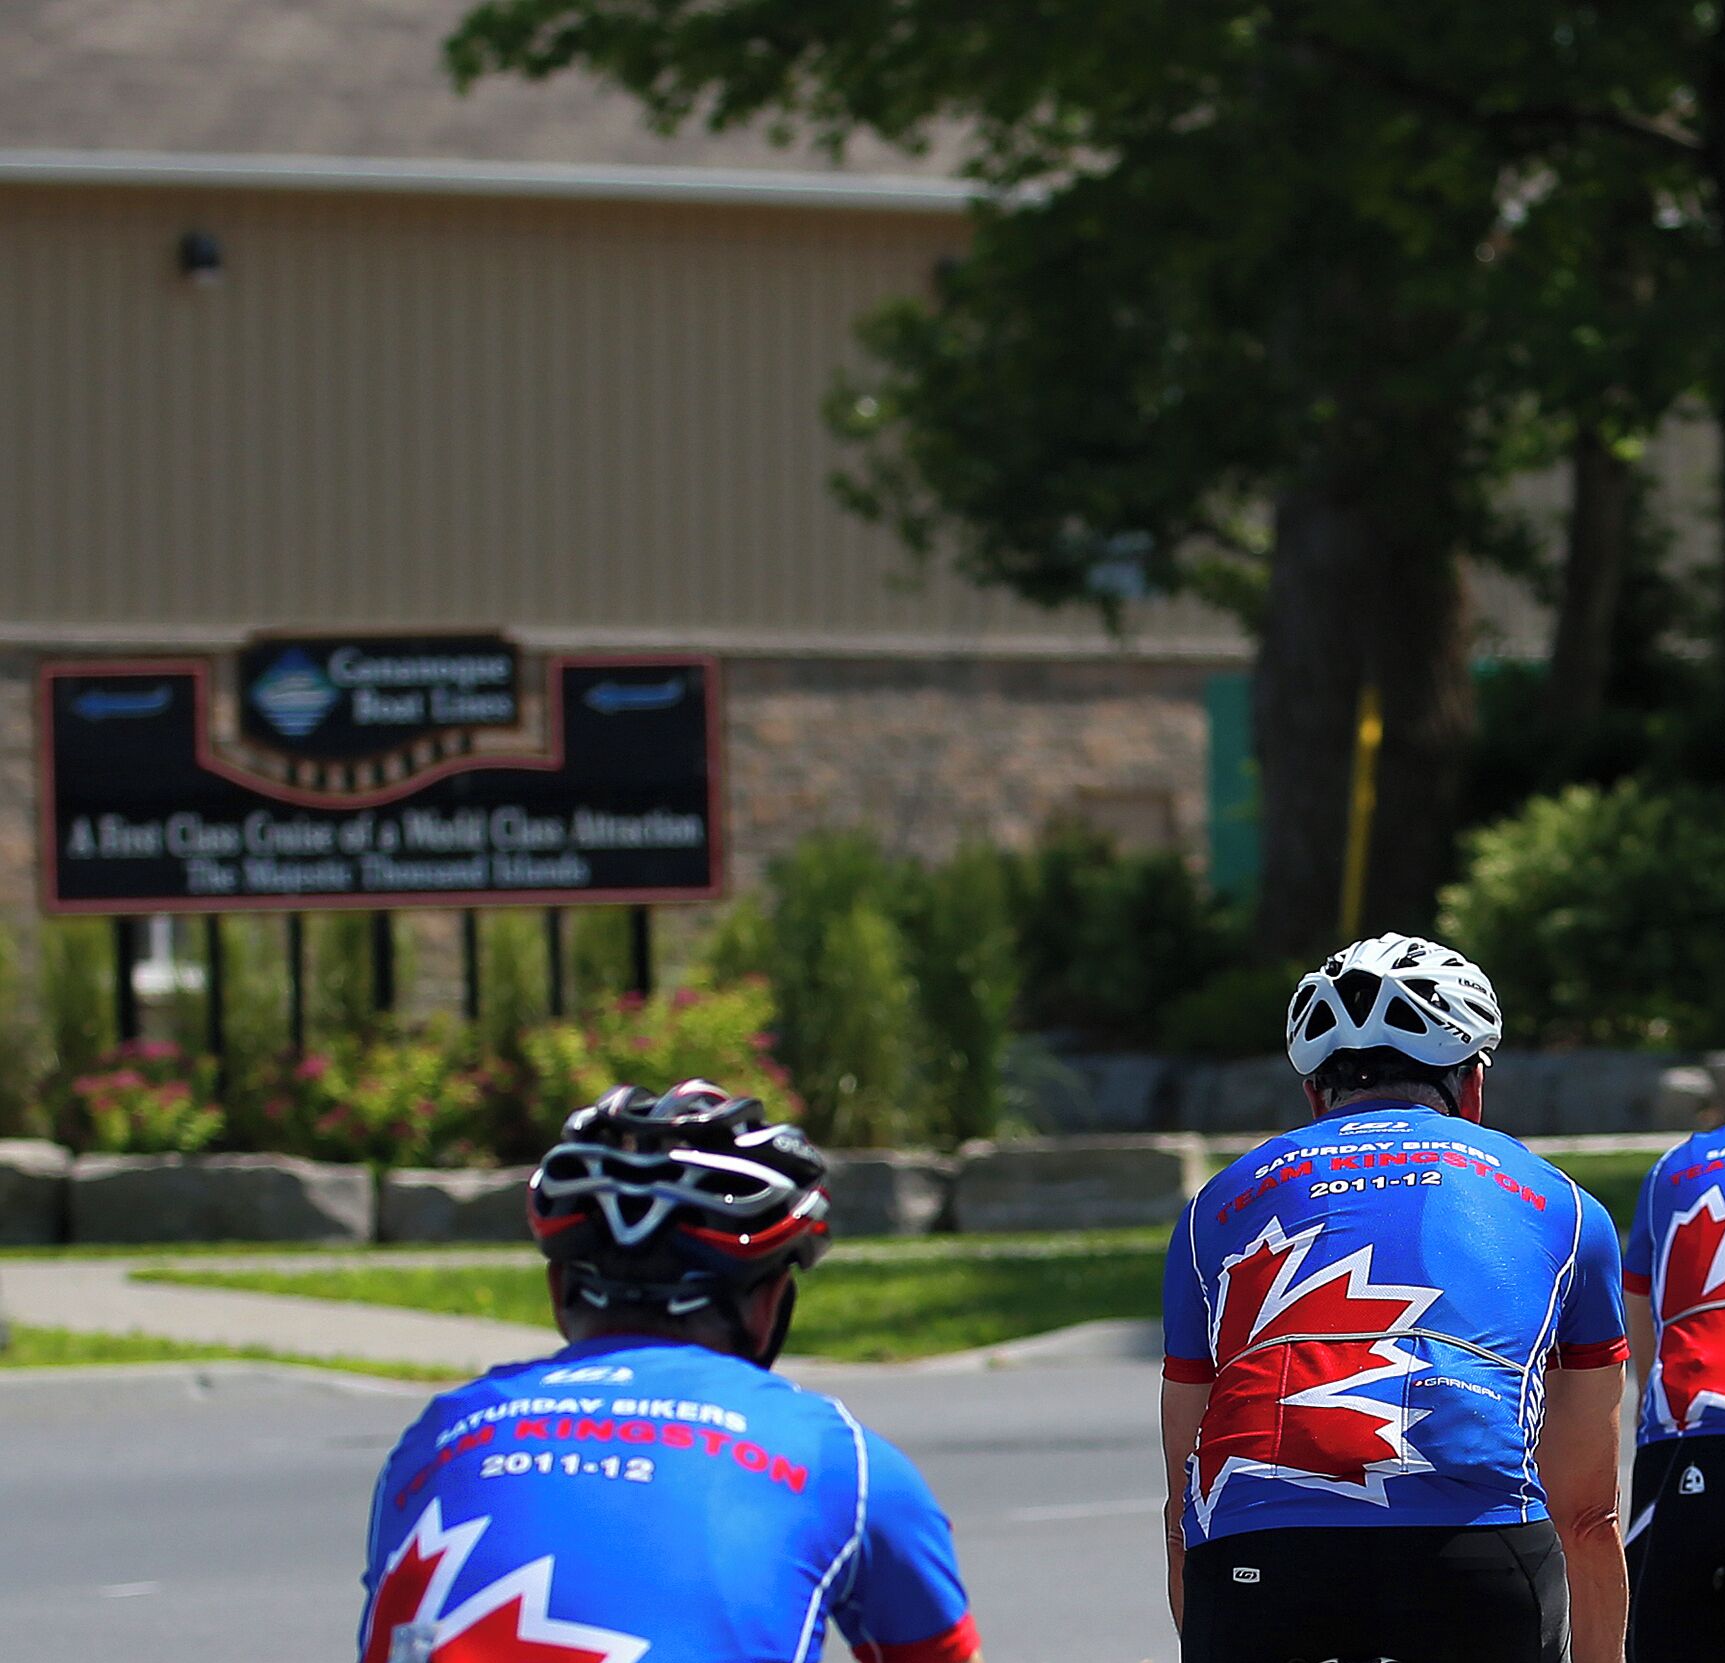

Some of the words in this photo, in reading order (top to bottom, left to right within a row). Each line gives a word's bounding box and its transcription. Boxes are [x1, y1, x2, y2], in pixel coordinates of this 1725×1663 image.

[1254, 1142, 1395, 1178] SATURDAY
[1402, 1141, 1502, 1167] BIKERS
[1216, 1160, 1313, 1225] TEAM
[1331, 1152, 1547, 1213] KINGSTON
[1309, 1171, 1443, 1199] 2011-12
[1424, 1377, 1502, 1401] GARNEAU
[435, 1398, 605, 1448] SATURDAY
[611, 1398, 748, 1433] BIKERS
[480, 1451, 656, 1483] 2011-12
[514, 1417, 808, 1494] KINGSTON
